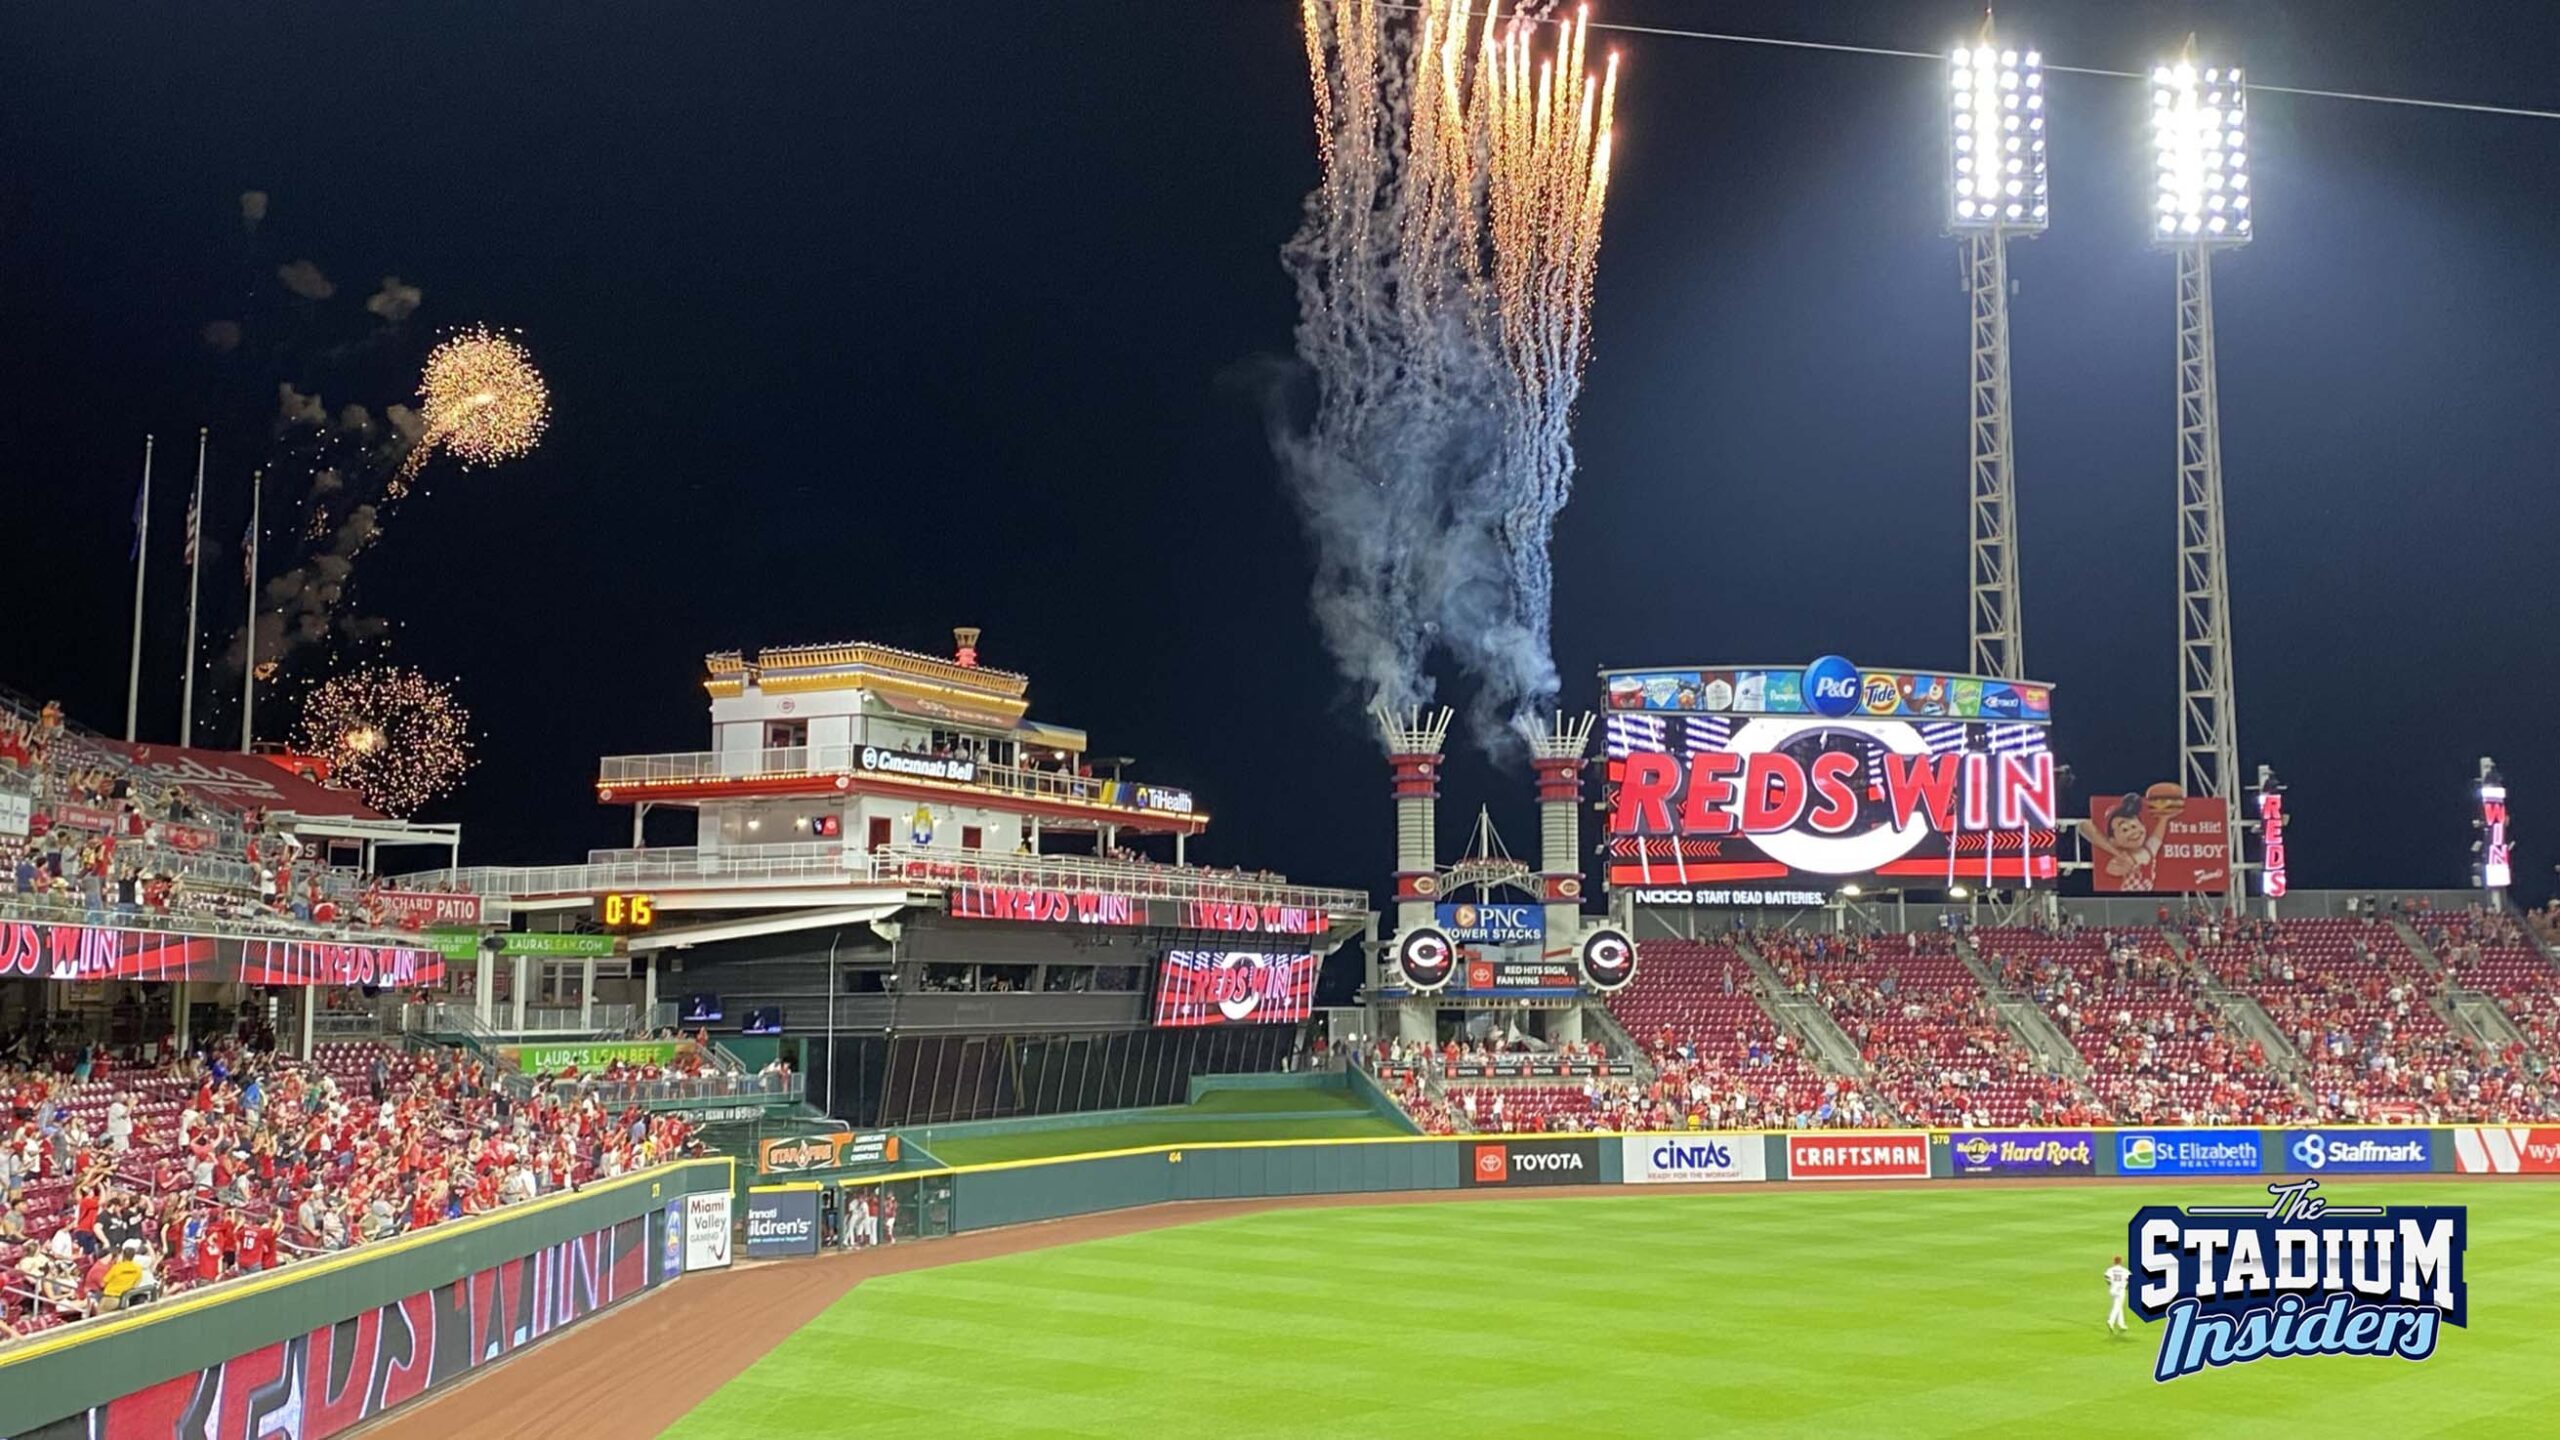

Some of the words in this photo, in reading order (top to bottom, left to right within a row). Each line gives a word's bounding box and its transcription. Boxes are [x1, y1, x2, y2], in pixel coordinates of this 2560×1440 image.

[1815, 677, 1856, 699] P&G
[1864, 683, 1896, 707] Tide
[878, 751, 947, 778] Cincinnati
[947, 760, 973, 781] Bell
[1147, 789, 1193, 813] TriHealth
[1615, 752, 1859, 835] REDS
[1883, 751, 2058, 832] WIN
[2169, 821, 2188, 833] It's
[2189, 824, 2197, 833] a
[2198, 821, 2222, 833] Hit!
[2485, 803, 2511, 867] WIN
[2164, 844, 2190, 858] BIG
[2193, 844, 2224, 858] BOY
[2262, 795, 2287, 897] REDS
[374, 895, 433, 912] ORCHARD
[436, 900, 475, 919] PATIO
[993, 889, 1069, 922] REDS
[1077, 892, 1128, 924] WIN
[1636, 890, 1693, 903] NOCO
[1695, 891, 1731, 904] START
[1732, 891, 1762, 904] DEAD
[606, 895, 651, 925] 0:15
[1199, 901, 1258, 932] REDS
[1262, 905, 1303, 934] WIN
[1478, 908, 1528, 928] PNC
[1492, 929, 1541, 940] STACKS
[51, 926, 118, 978] WIN
[508, 939, 603, 951] LAURASLEAN.COM
[320, 944, 375, 986] REDS
[378, 949, 416, 987] WIN
[1504, 966, 1522, 975] RED
[1523, 966, 1543, 975] HITS
[1190, 967, 1250, 1003] REDS
[1252, 966, 1291, 1000] WIN
[1496, 976, 1514, 985] FAN
[1515, 976, 1539, 985] WINS
[1540, 976, 1576, 985] TUNDRA
[535, 1049, 590, 1066] LAURA'S
[629, 1047, 661, 1063] BEEF
[1932, 1134, 1950, 1145] 370
[770, 1148, 798, 1165] STAR
[1796, 1146, 1920, 1166] CRAFTSMAN
[2001, 1141, 2046, 1163] Hard
[2046, 1141, 2090, 1165] Rock
[2178, 1142, 2257, 1160] Elizabeth
[1513, 1152, 1584, 1171] TOYOTA
[2179, 1160, 2257, 1168] HEALTHCARE
[690, 1198, 725, 1215] Miami
[695, 1215, 727, 1233] Valley
[470, 1231, 600, 1367] WIN
